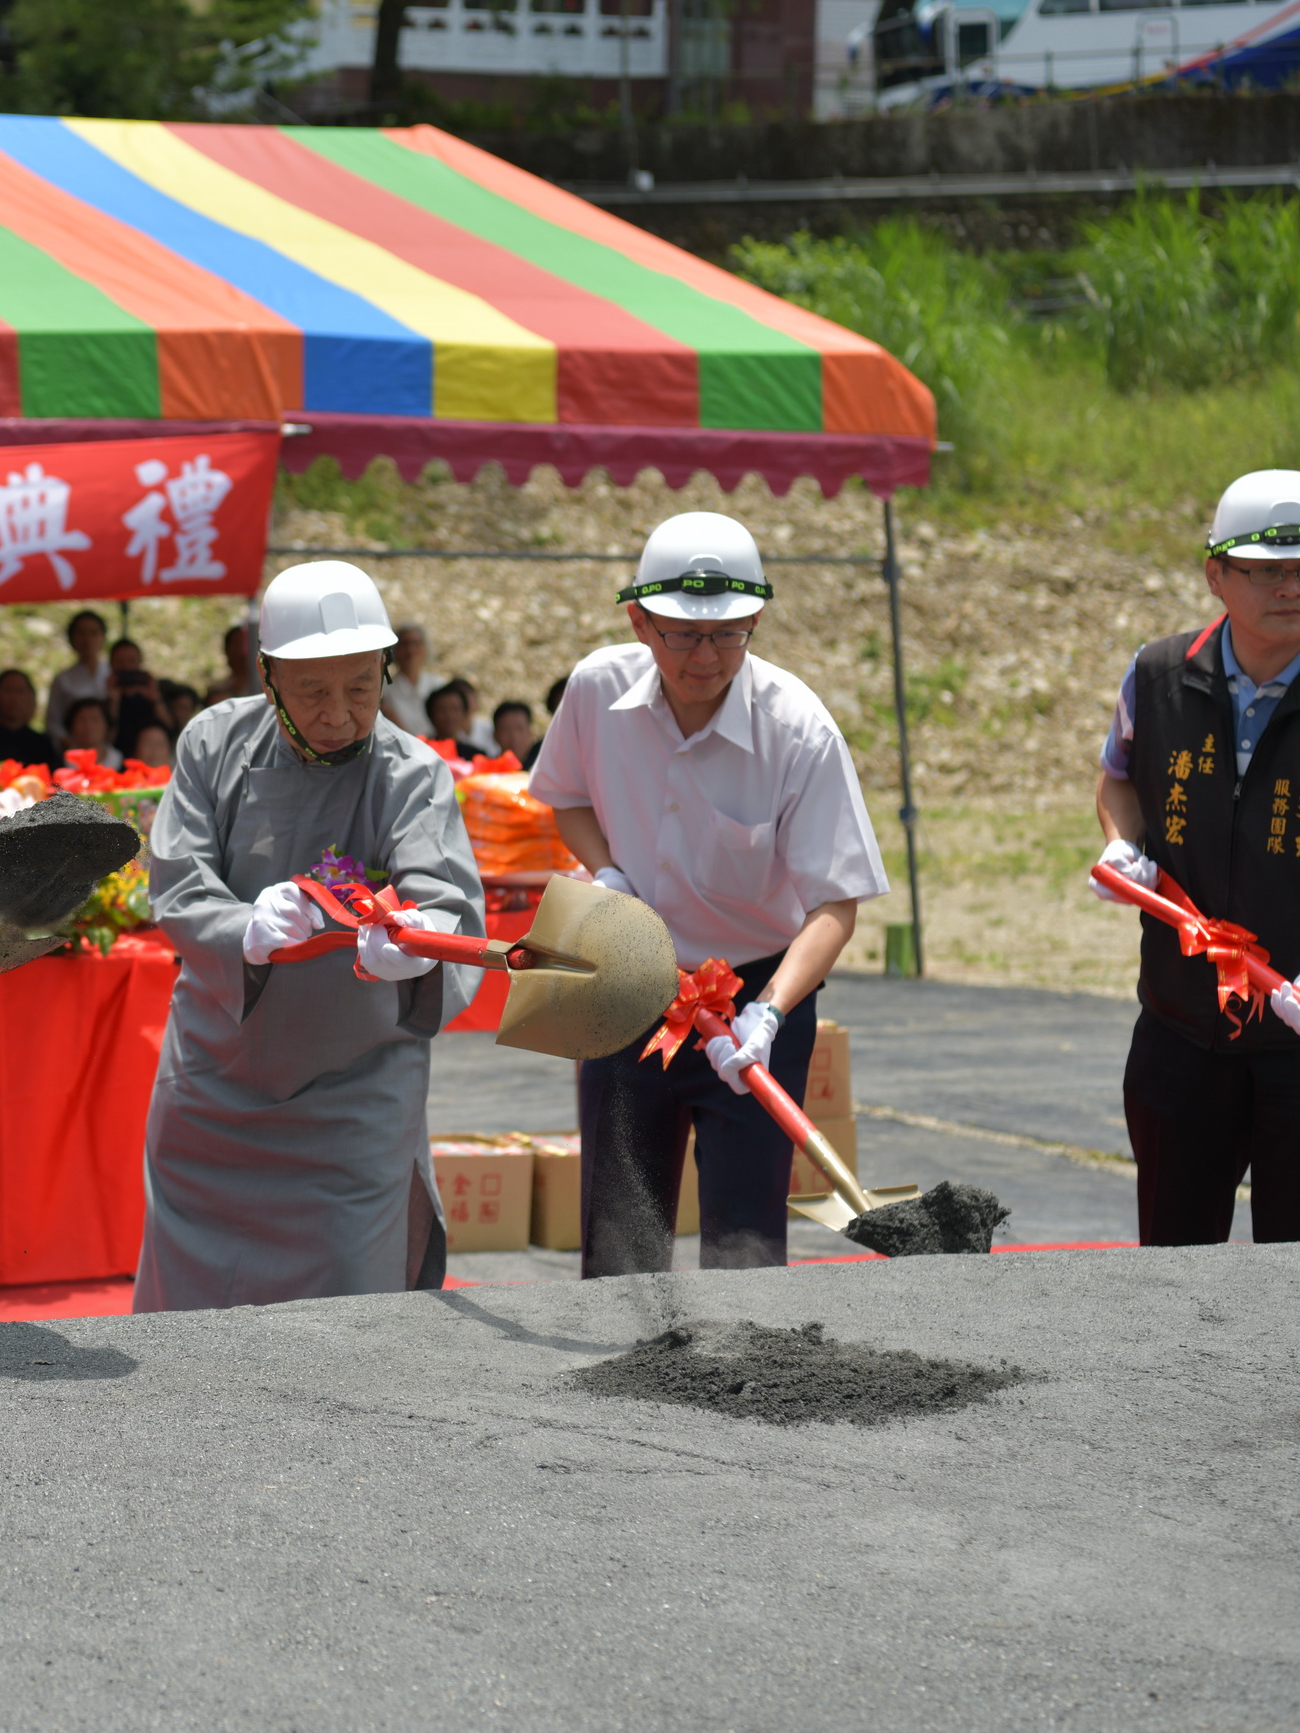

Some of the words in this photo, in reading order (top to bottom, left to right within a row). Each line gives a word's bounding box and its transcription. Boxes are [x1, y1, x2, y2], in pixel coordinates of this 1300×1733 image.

[1198, 733, 1216, 775] 主任
[1166, 750, 1193, 846] 潘杰宏
[1267, 779, 1291, 855] 服務團隊
